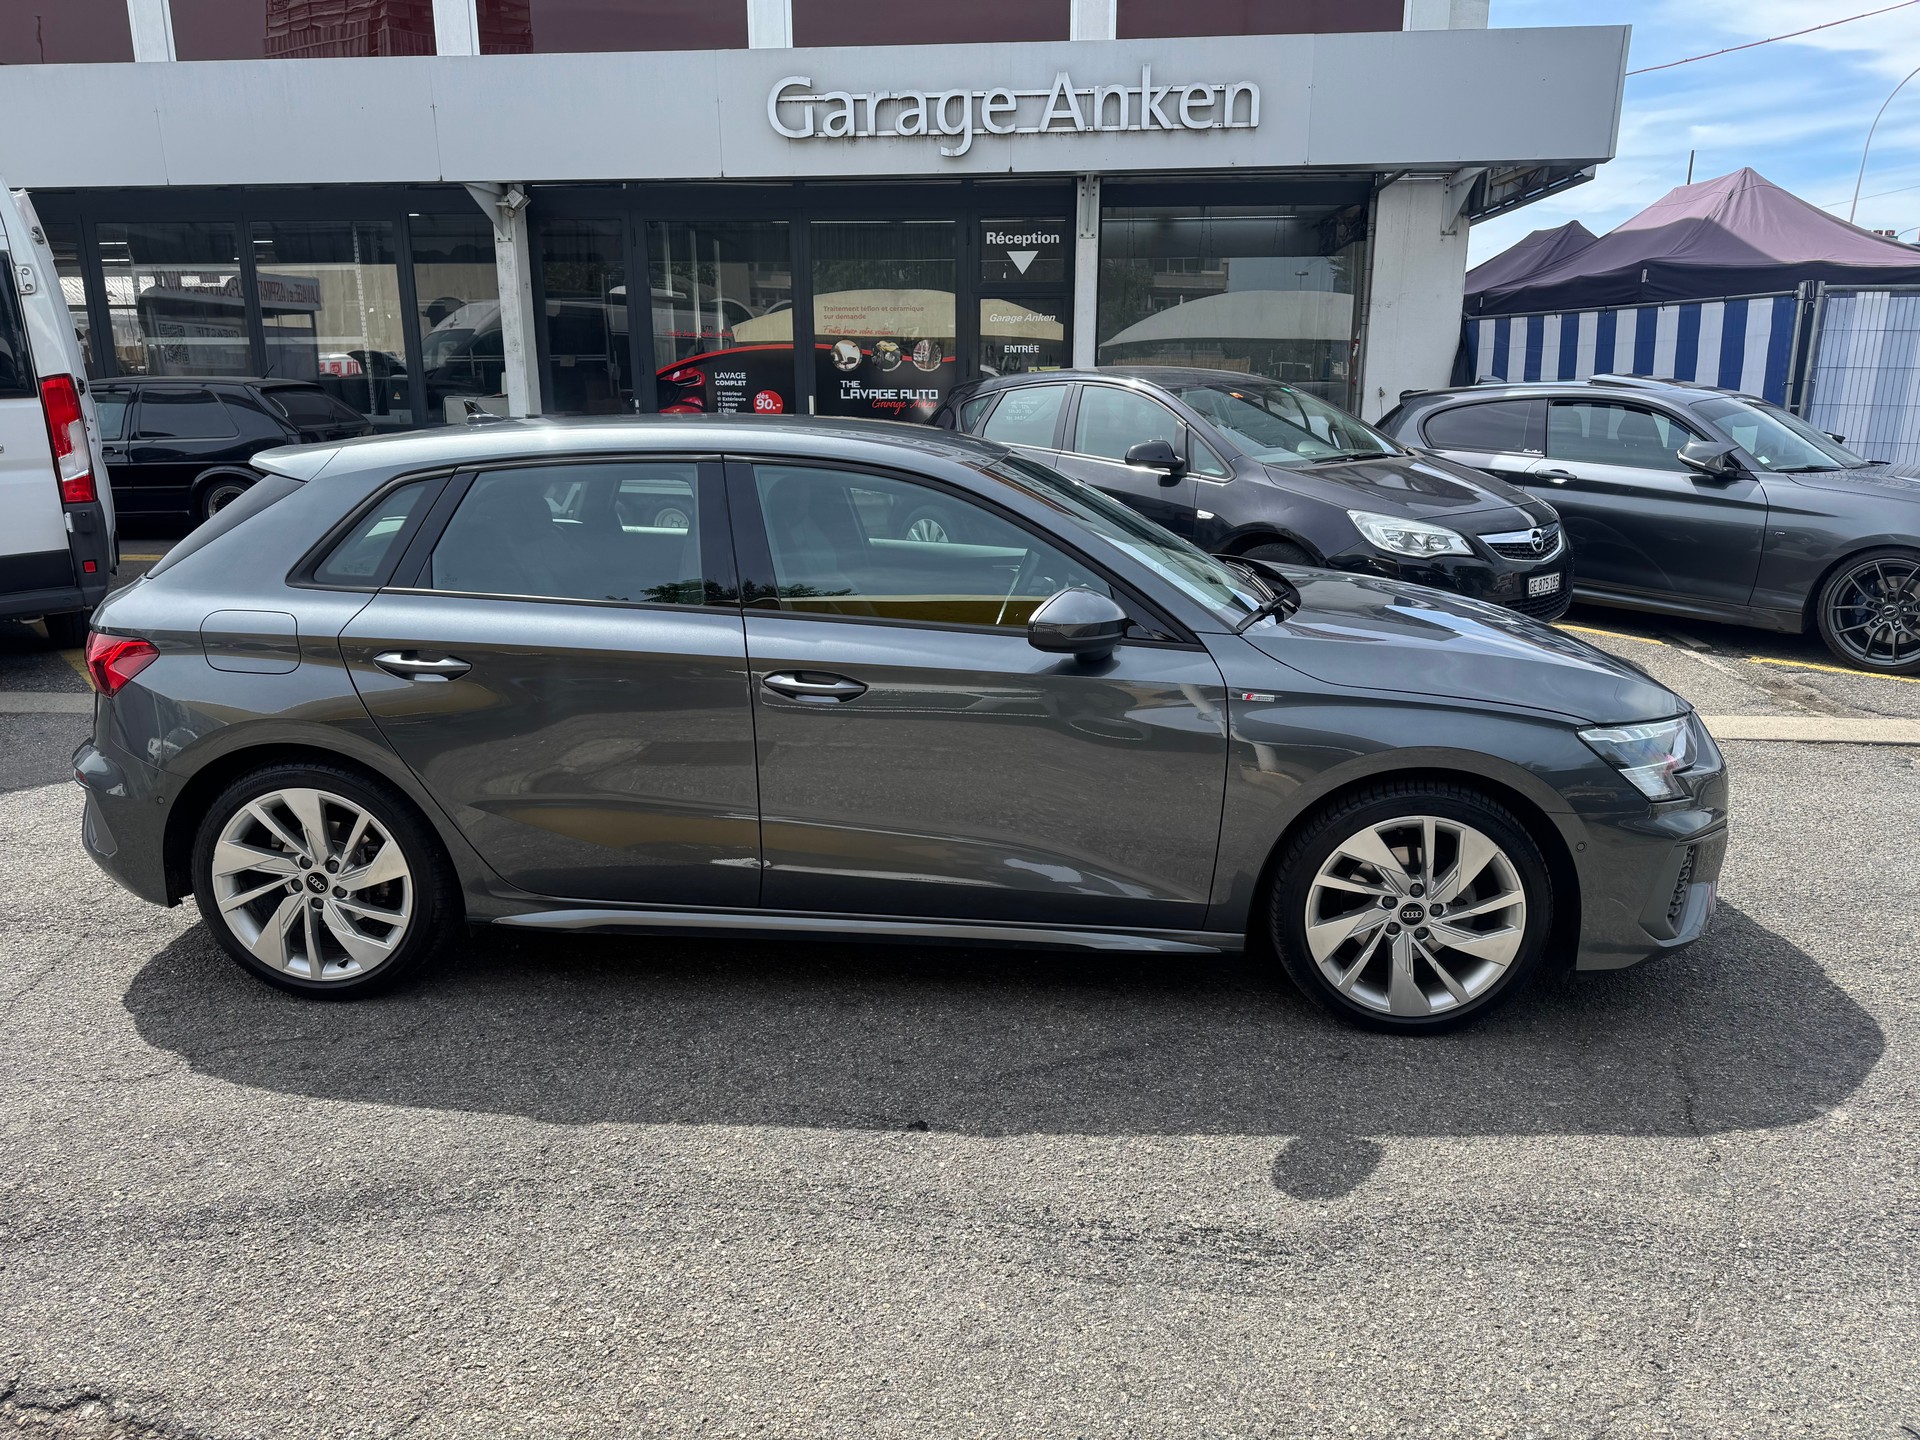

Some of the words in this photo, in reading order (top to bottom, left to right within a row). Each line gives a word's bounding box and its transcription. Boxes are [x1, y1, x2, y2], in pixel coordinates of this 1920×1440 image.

[766, 75, 1017, 158] Garage
[1038, 63, 1261, 132] Anken
[986, 231, 1060, 246] Réception
[860, 304, 880, 312] téflon
[989, 313, 1023, 324] Garage
[1024, 313, 1056, 322] Anken
[1004, 343, 1040, 353] ENTRÉE
[840, 380, 860, 388] THE
[840, 389, 898, 399] LAVAGE
[900, 389, 939, 399] AUTO
[871, 399, 907, 415] Garage
[1530, 579, 1537, 593] GE
